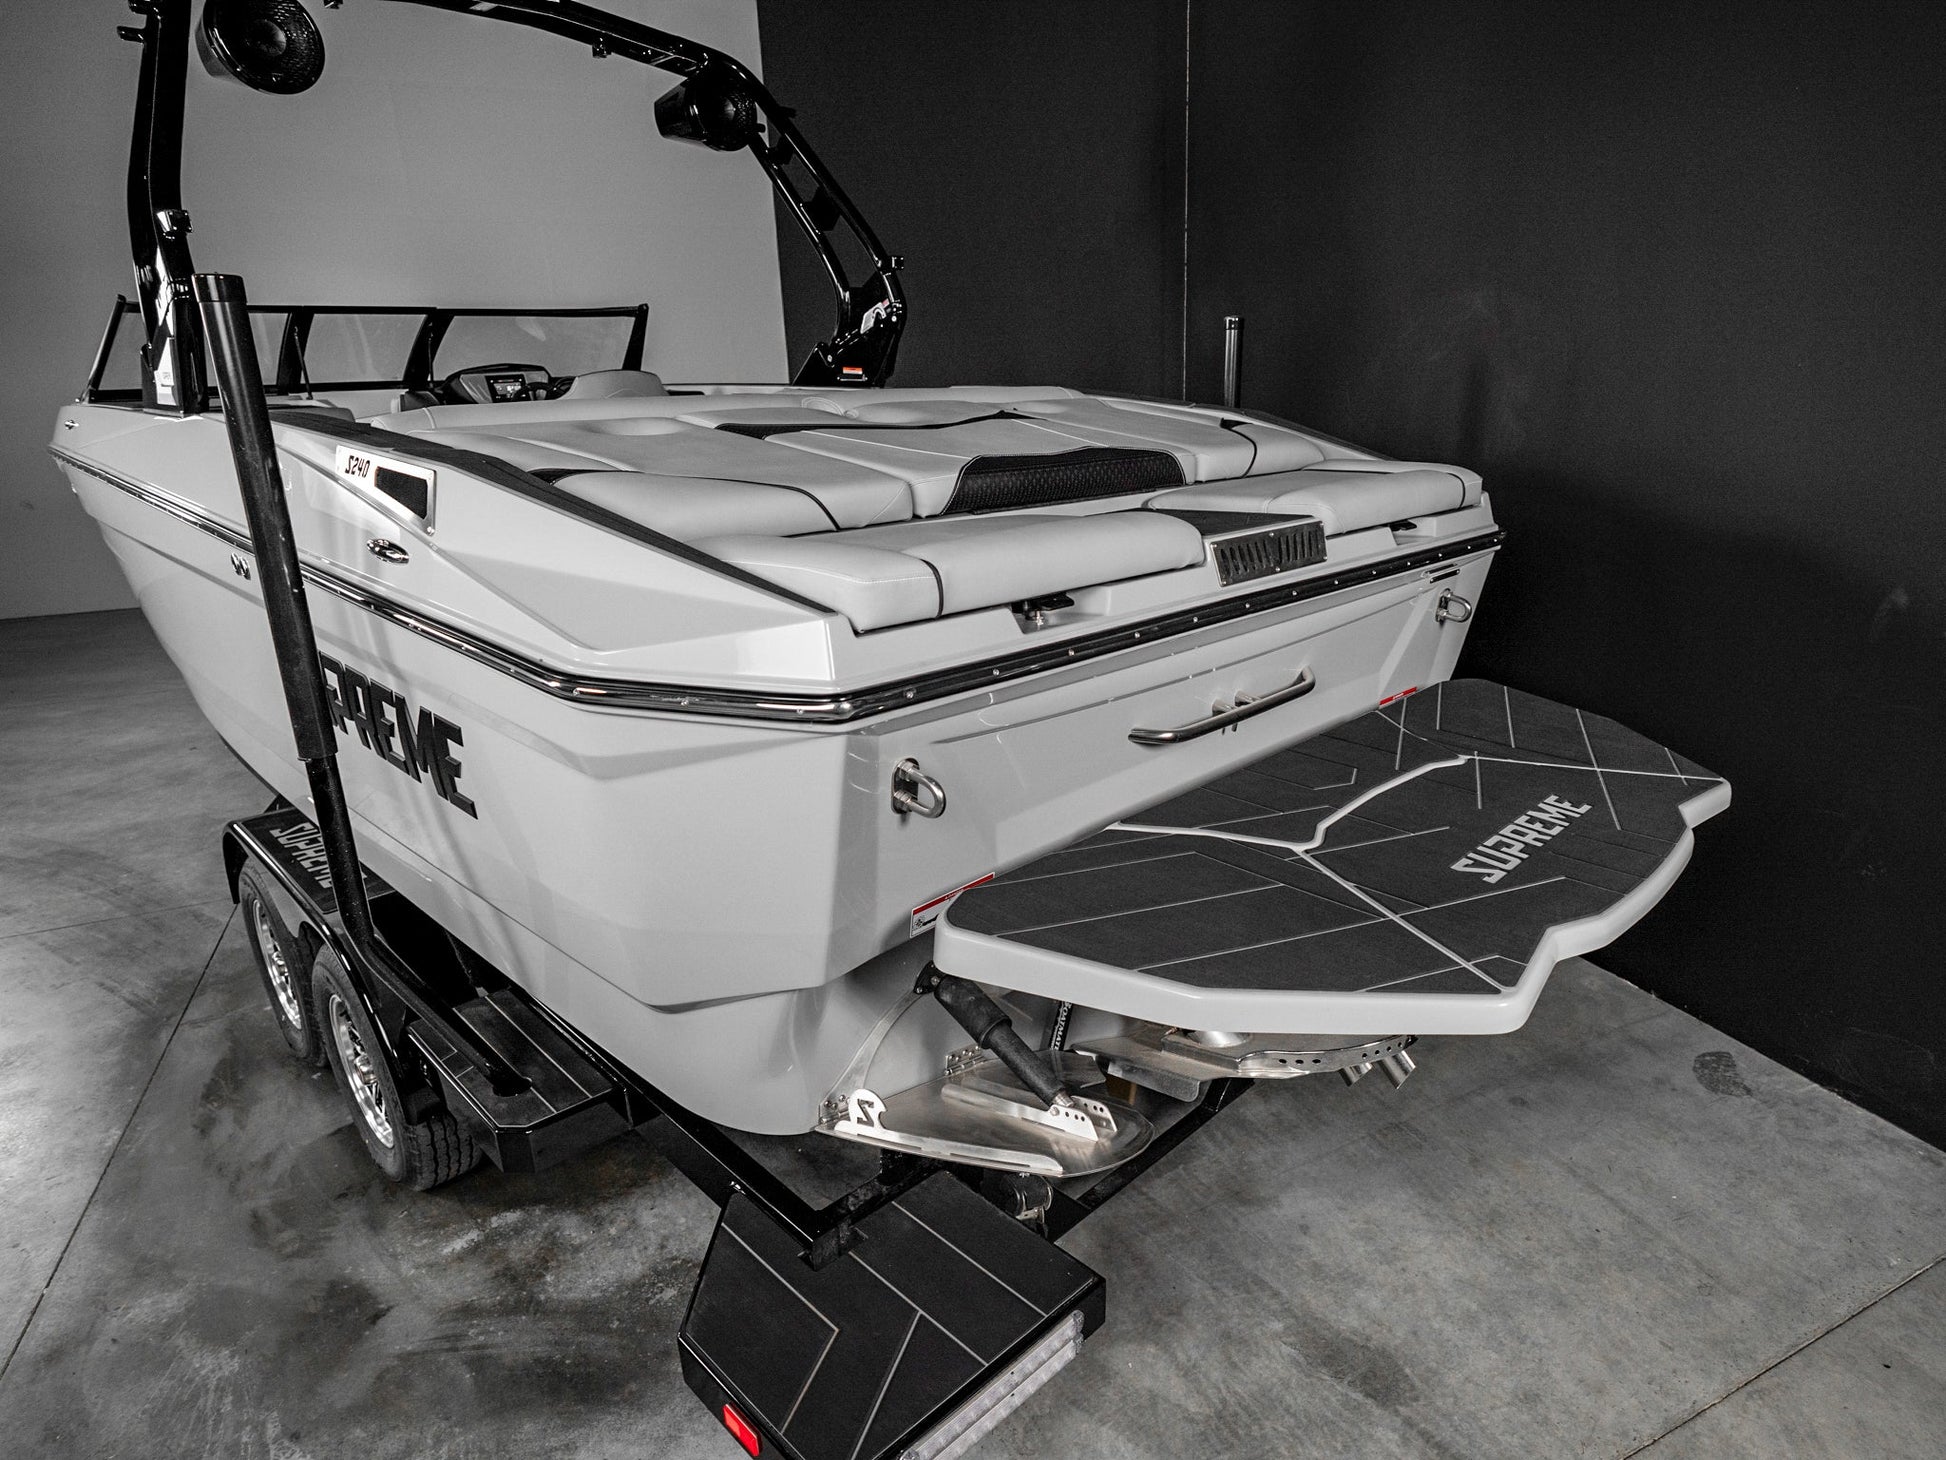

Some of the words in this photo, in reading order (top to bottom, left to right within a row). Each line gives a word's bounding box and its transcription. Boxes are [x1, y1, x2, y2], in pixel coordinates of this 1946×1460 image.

[345, 455, 370, 478] S240
[319, 650, 478, 820] PREME
[1450, 795, 1593, 884] SUPREME
